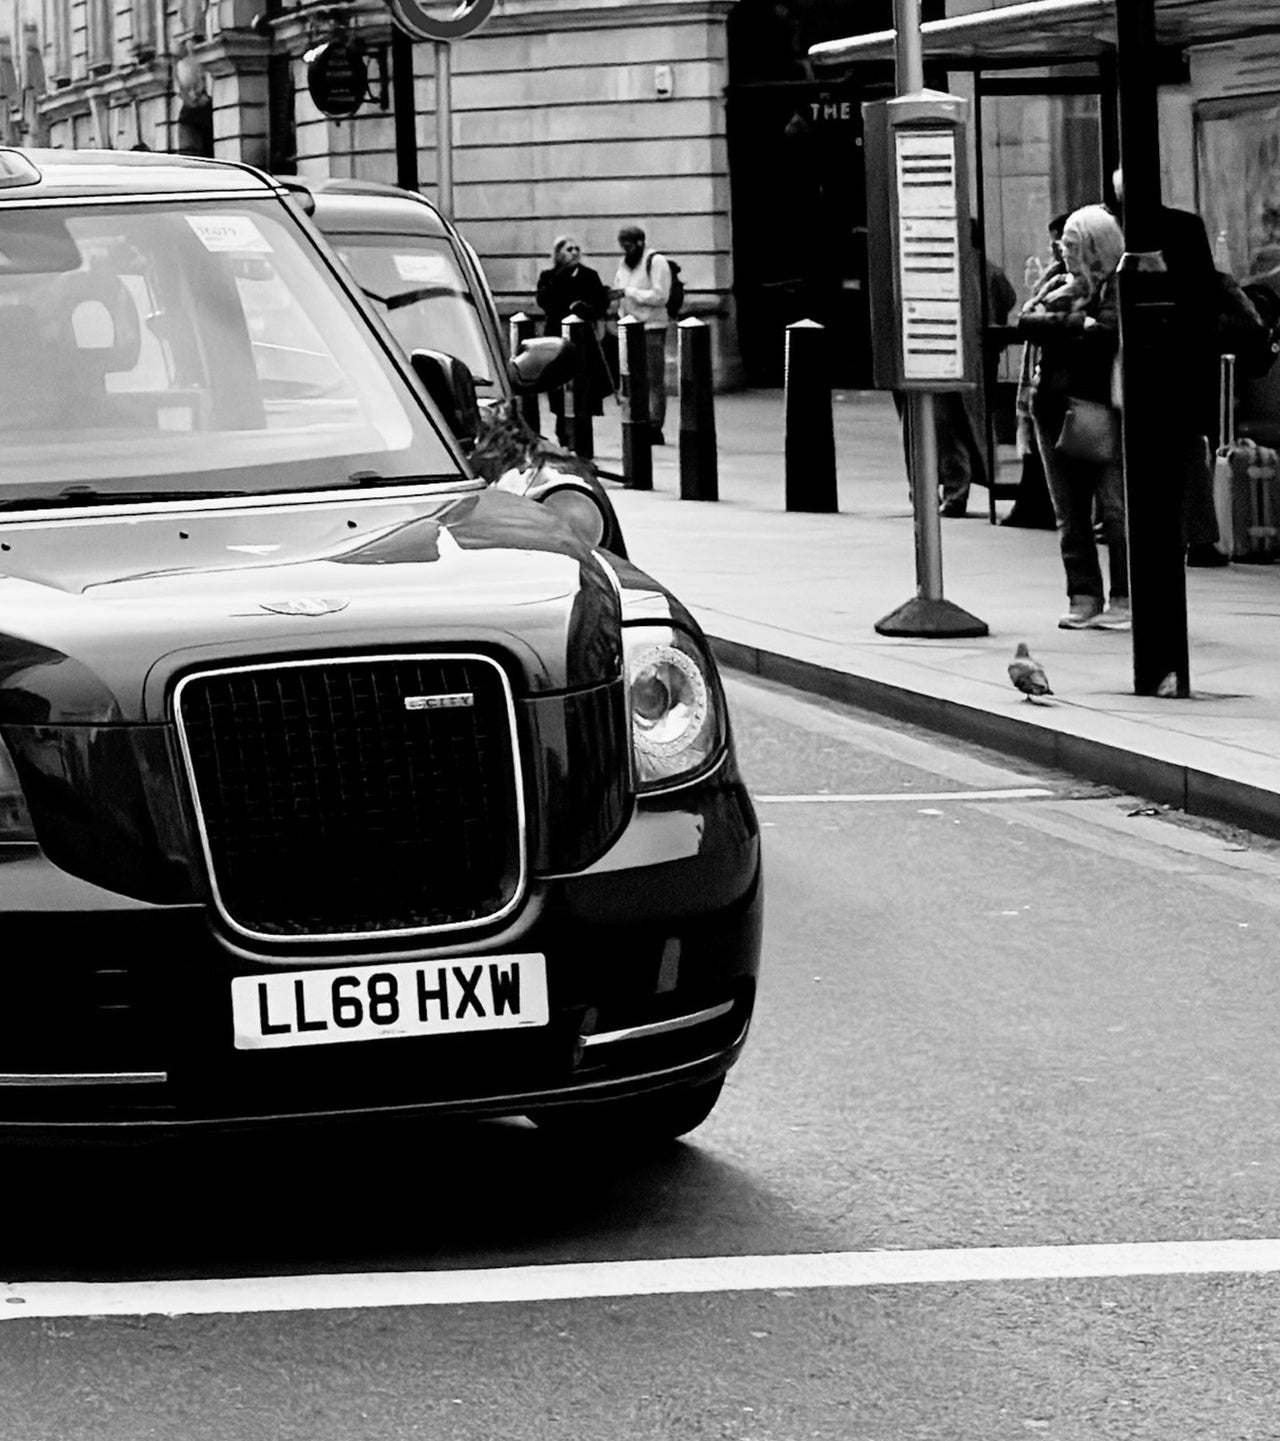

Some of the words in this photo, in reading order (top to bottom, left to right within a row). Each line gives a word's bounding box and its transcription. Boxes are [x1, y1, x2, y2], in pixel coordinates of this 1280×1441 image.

[810, 102, 851, 120] THE
[257, 972, 401, 1036] LL68
[415, 962, 522, 1023] HXW
